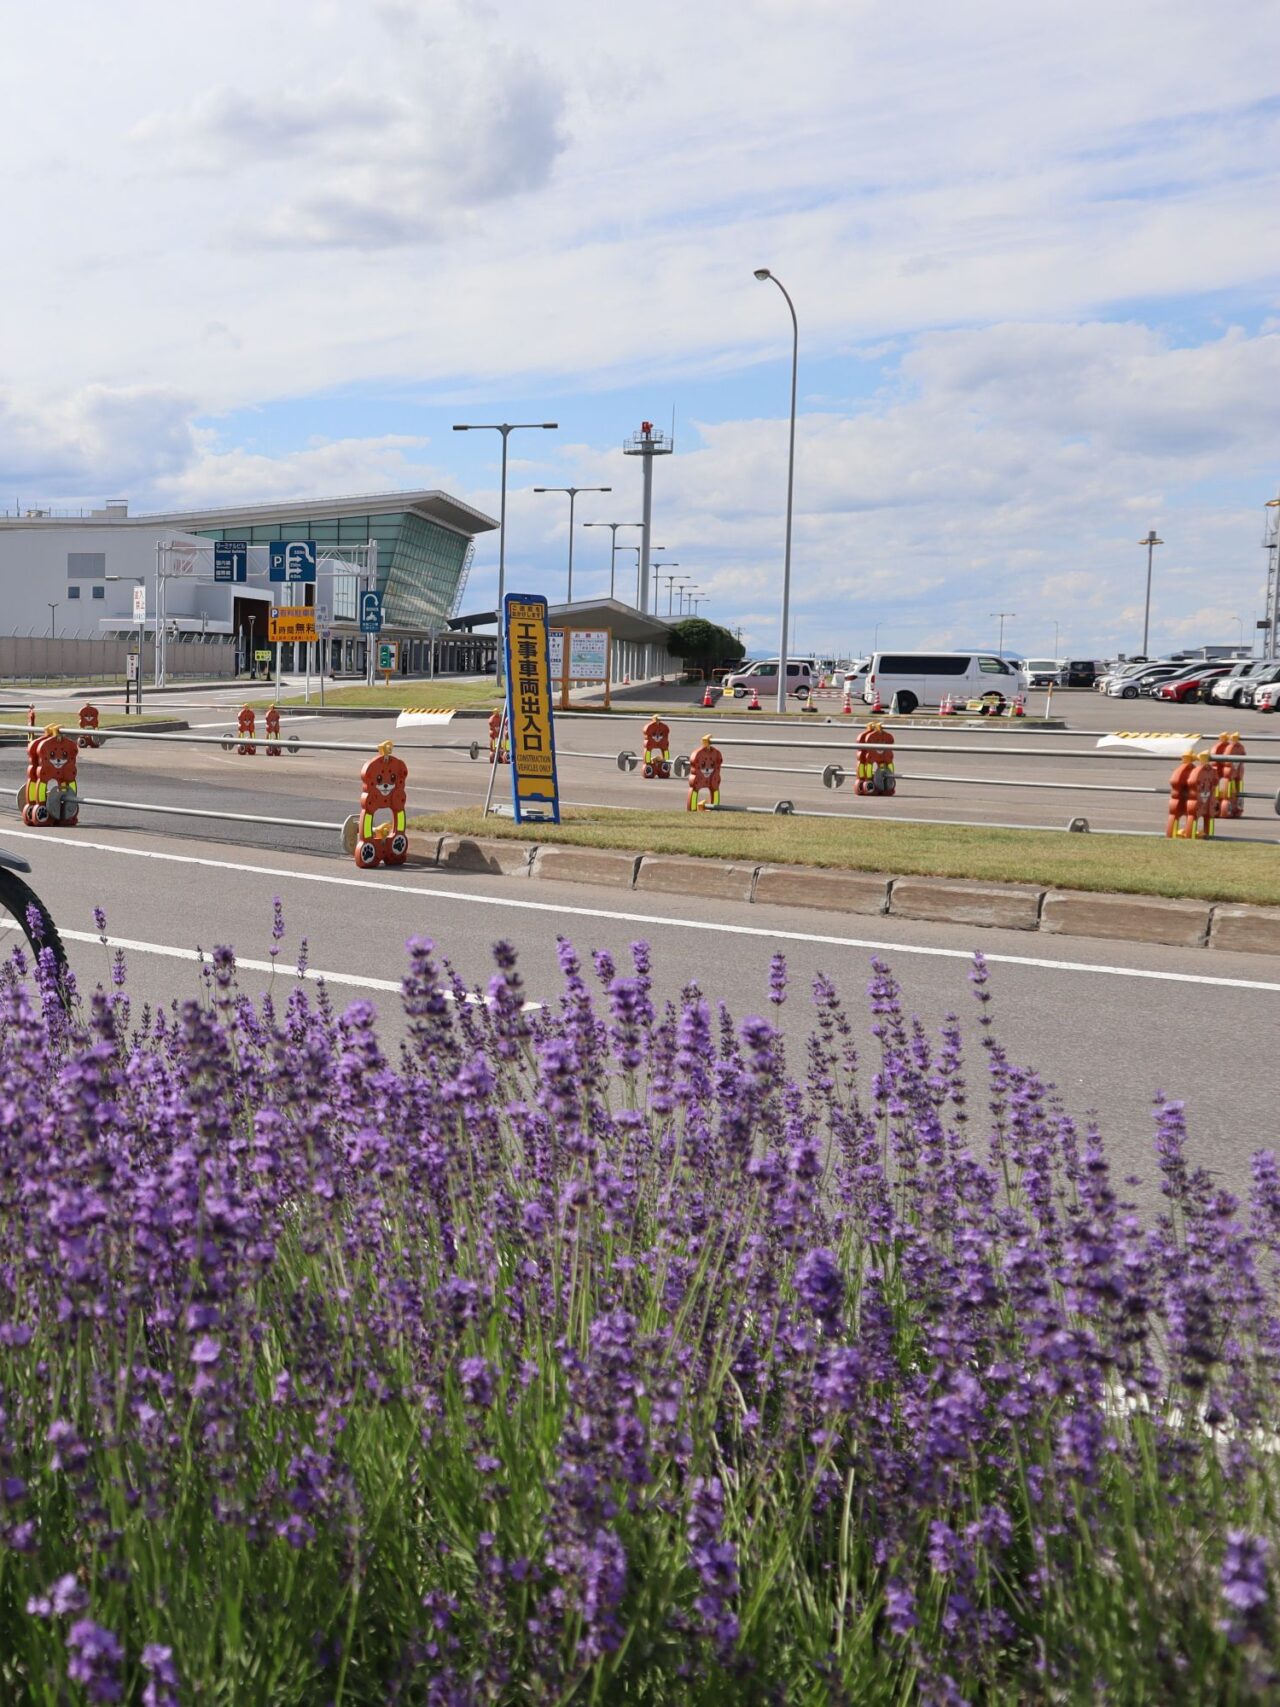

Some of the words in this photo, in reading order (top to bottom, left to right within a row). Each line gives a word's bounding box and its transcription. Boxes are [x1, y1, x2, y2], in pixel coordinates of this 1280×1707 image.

[274, 556, 282, 567] P
[272, 609, 277, 618] P
[517, 623, 542, 751] 工事車両出入口
